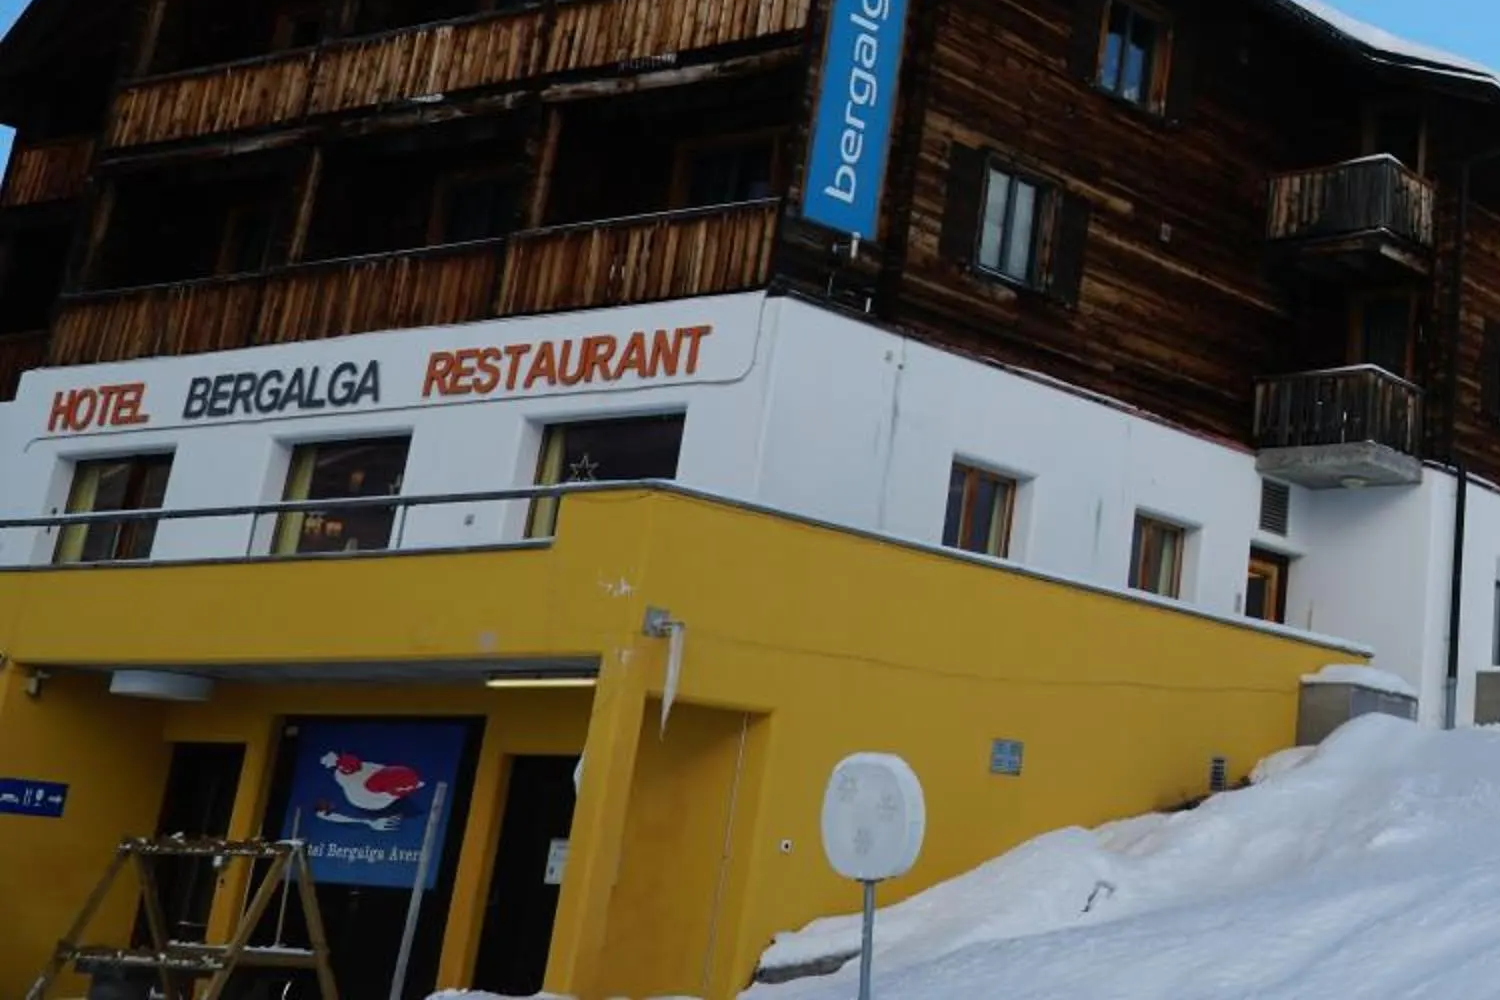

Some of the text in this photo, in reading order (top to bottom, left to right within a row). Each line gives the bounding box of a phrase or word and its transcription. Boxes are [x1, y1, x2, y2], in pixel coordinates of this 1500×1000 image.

[47, 325, 712, 432] HOTEL BERGALGA RESTAURANT
[389, 845, 421, 862] Aver
